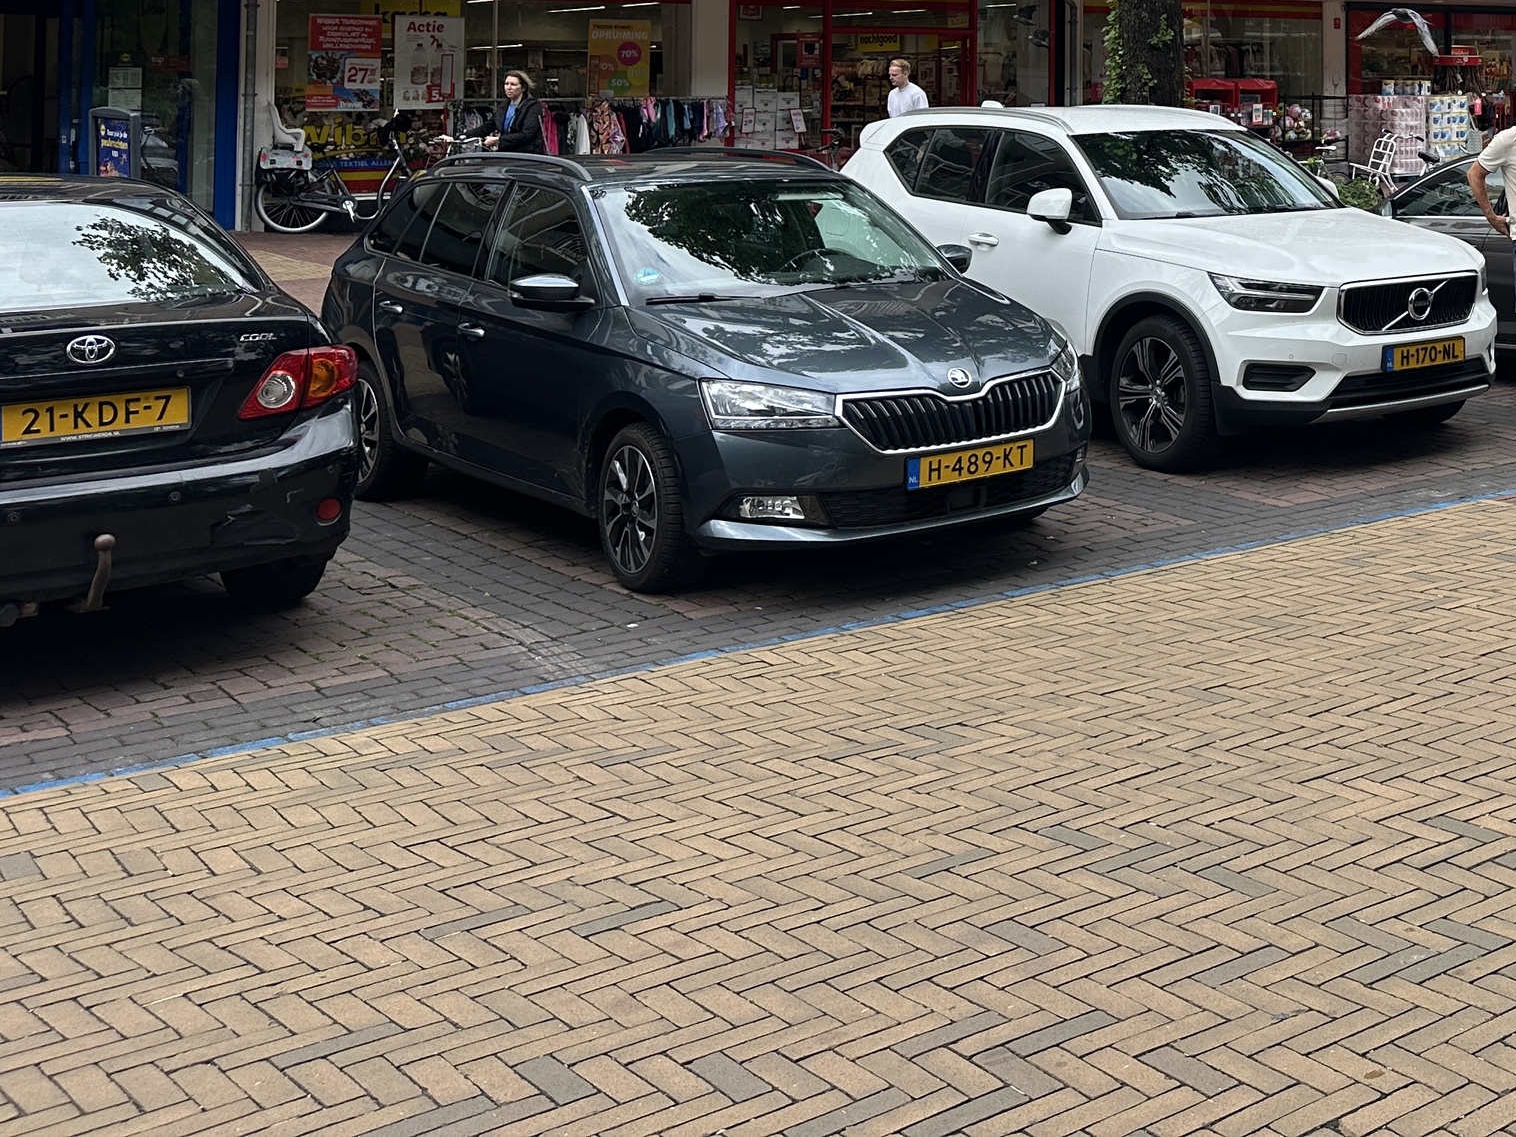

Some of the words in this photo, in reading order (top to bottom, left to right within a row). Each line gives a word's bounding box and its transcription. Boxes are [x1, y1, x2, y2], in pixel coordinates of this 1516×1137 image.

[406, 20, 445, 33] Actie
[591, 30, 648, 40] OPRUIMING
[860, 34, 897, 46] nachtgoed
[620, 50, 639, 58] 70%
[347, 66, 370, 84] 27
[611, 78, 630, 87] 50%
[1400, 343, 1459, 367] H-170-NL
[22, 395, 172, 436] 21-KDF-7
[928, 444, 1028, 482] H-489-KT
[908, 476, 919, 484] NL
